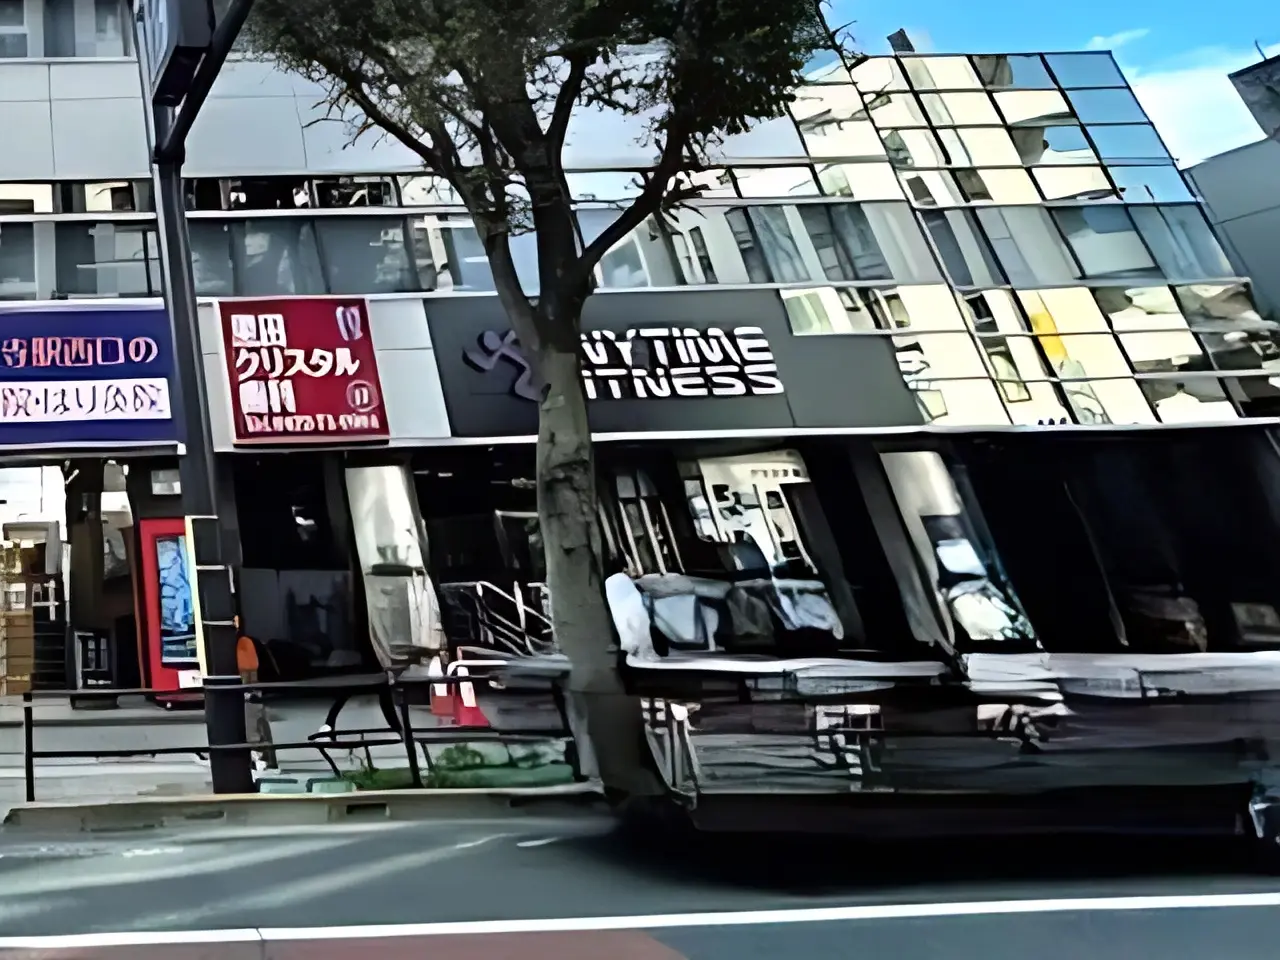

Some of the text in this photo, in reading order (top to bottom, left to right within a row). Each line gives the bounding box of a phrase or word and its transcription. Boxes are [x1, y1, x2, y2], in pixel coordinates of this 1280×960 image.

[580, 326, 777, 366] NYTIME
[235, 347, 361, 382] クリスタル
[581, 363, 785, 399] ITNESS
